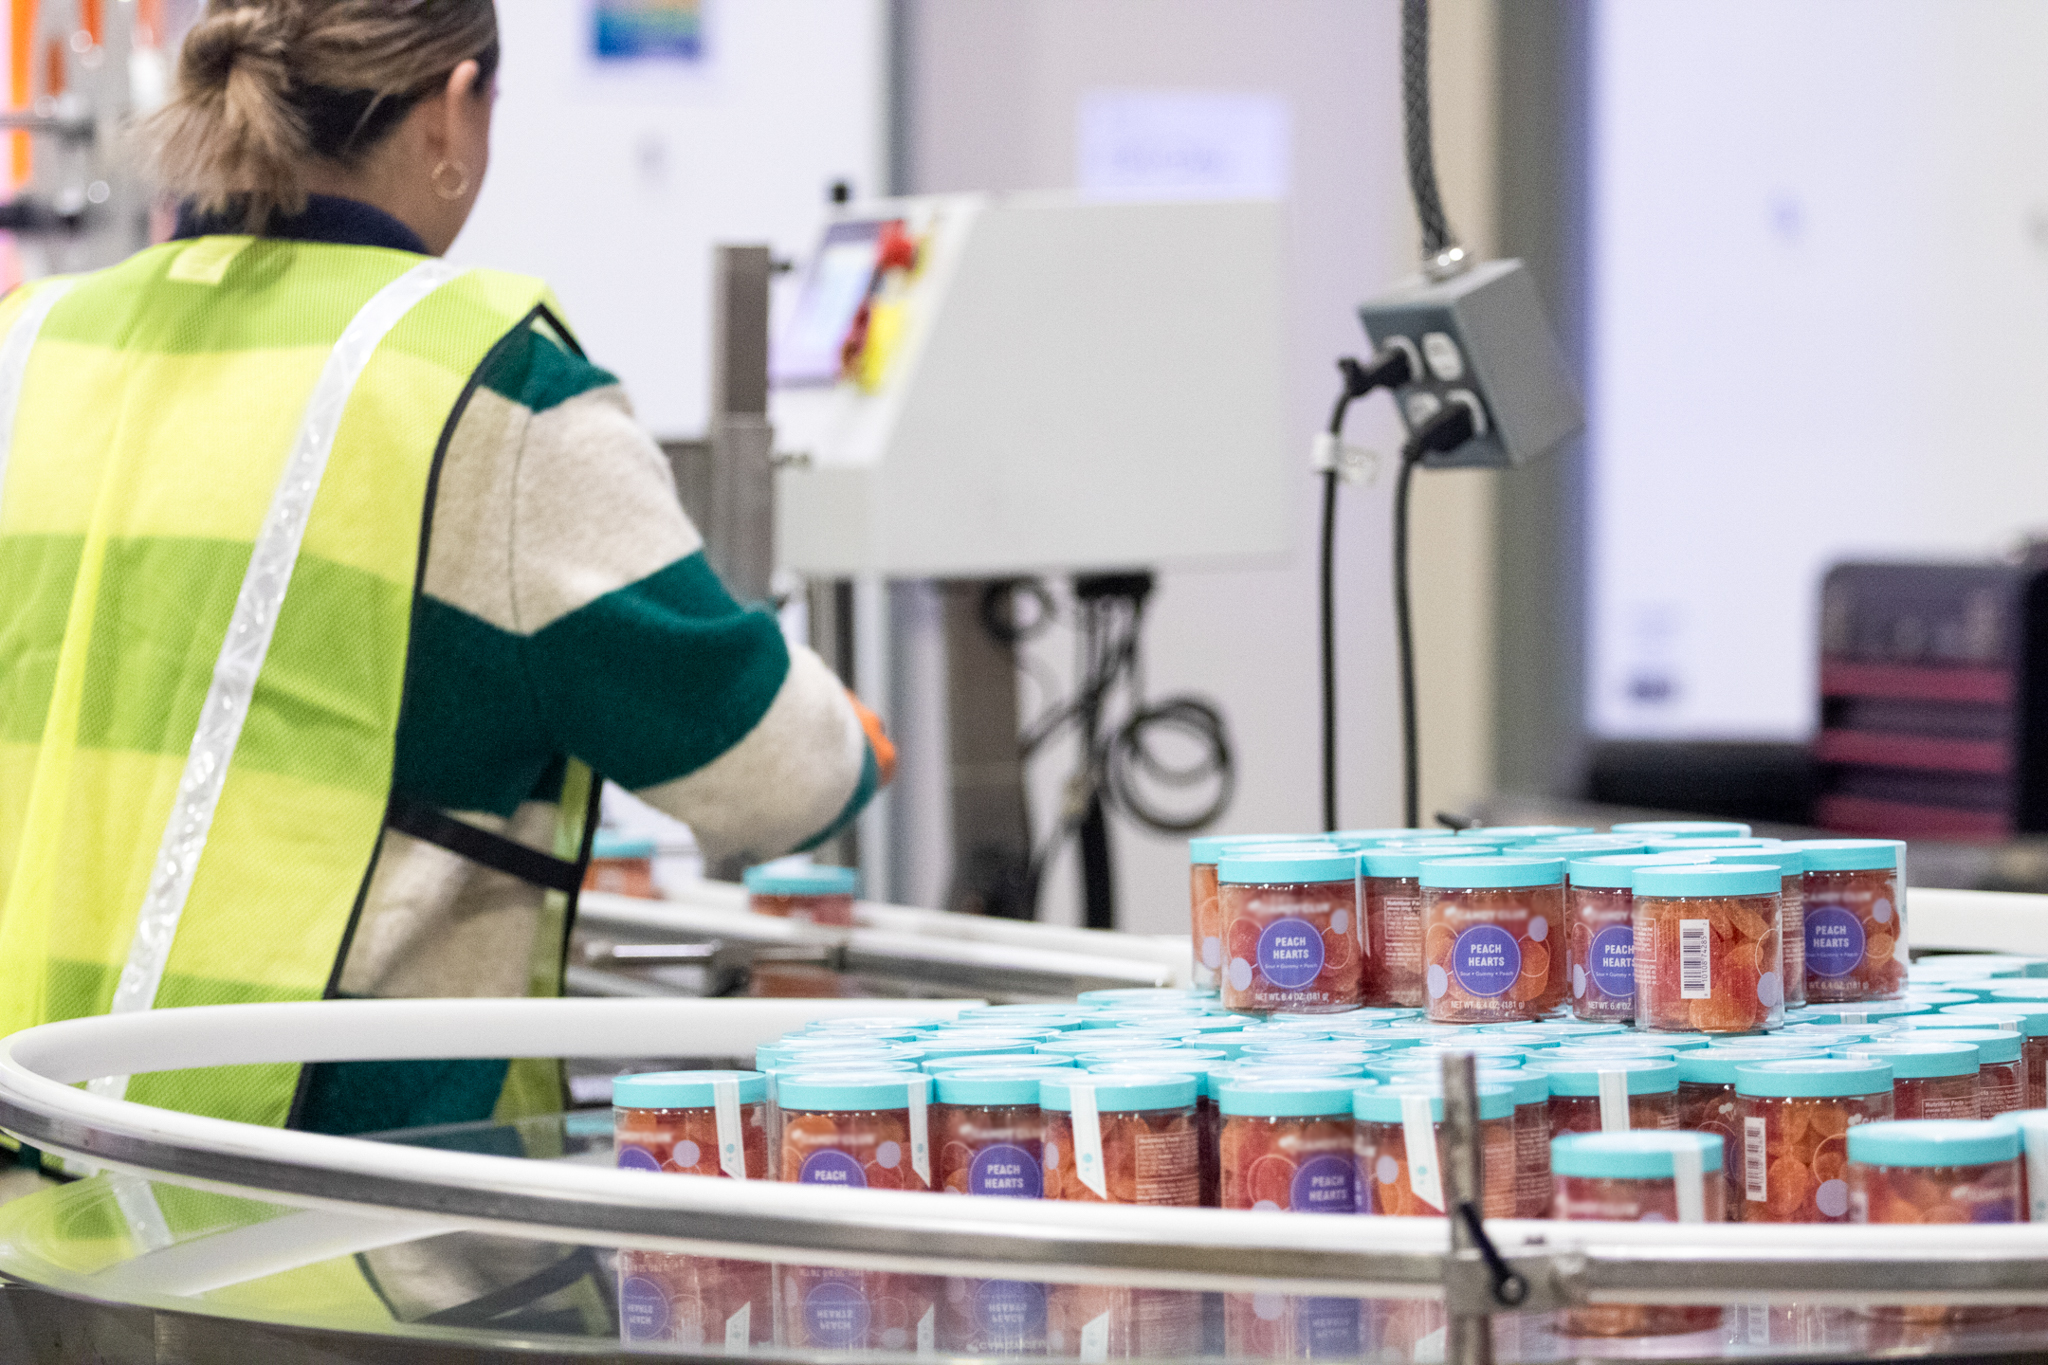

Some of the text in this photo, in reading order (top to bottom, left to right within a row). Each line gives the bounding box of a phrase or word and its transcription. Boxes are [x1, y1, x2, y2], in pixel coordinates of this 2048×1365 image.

[1815, 925, 1847, 935] PEACH
[1275, 936, 1306, 947] PEACH
[1813, 938, 1849, 948] HEARTS
[1470, 944, 1502, 954] PEACH
[1605, 945, 1635, 954] PEACH
[1273, 949, 1309, 960] HEARTS
[1468, 956, 1505, 967] HEARTS
[1255, 992, 1267, 1001] NET
[1450, 1001, 1462, 1009] NET
[1587, 1001, 1599, 1009] NET
[1610, 1001, 1621, 1010] 6.4
[987, 1164, 1021, 1175] PEACH
[815, 1170, 847, 1181] PEACH
[985, 1178, 1024, 1189] HEARTS
[1311, 1175, 1345, 1187] PEACH
